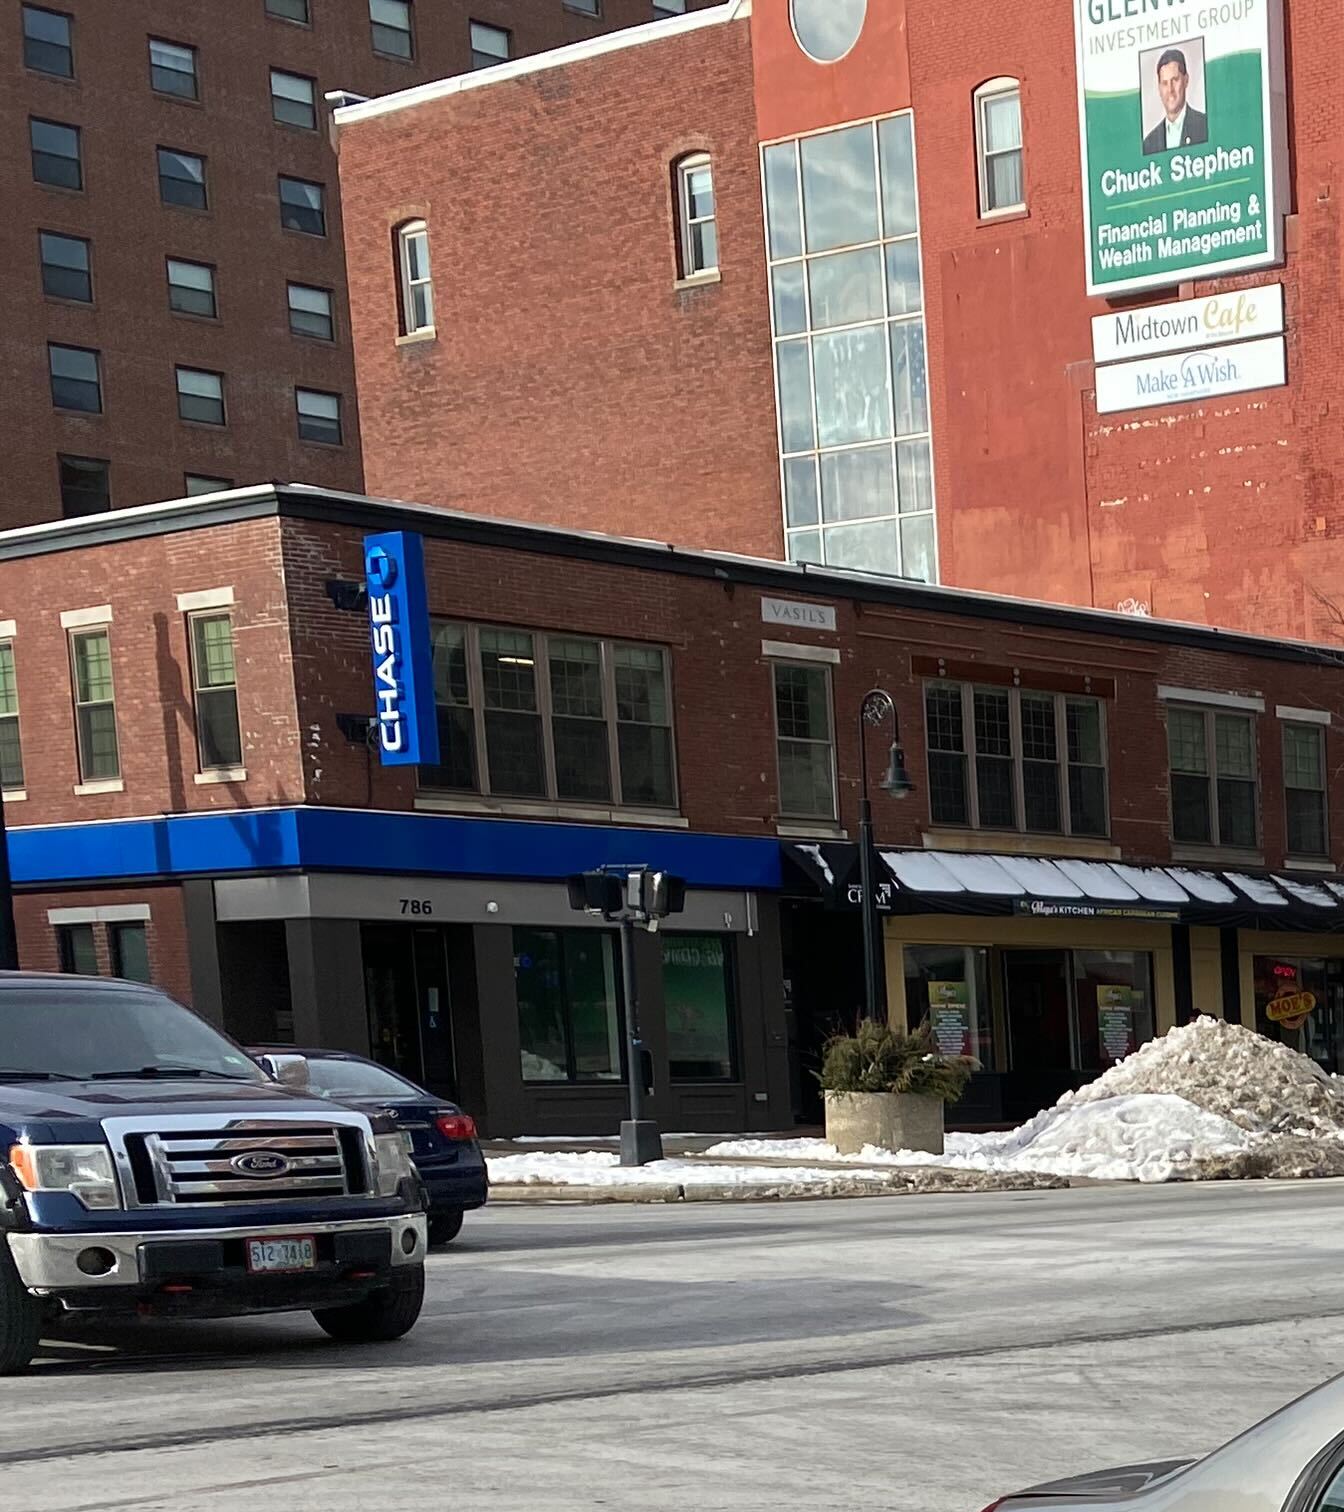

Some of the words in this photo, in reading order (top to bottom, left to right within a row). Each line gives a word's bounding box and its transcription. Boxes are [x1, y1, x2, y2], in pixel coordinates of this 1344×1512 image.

[1089, 14, 1191, 55] INVESTMENT
[1197, 0, 1254, 29] GROUP
[1101, 161, 1162, 197] Chuck
[1170, 144, 1254, 183] Stephen
[1098, 211, 1168, 248] Financial
[1172, 198, 1242, 231] Planning
[1247, 193, 1260, 215] &
[1099, 238, 1153, 270] Wealth
[1157, 220, 1263, 259] Management
[1114, 311, 1199, 347] Midtown
[1202, 294, 1257, 334] Cafe
[1136, 367, 1179, 396] Make
[1183, 366, 1197, 389] A
[1197, 357, 1238, 386] Wish
[370, 593, 403, 753] CHASE
[399, 899, 434, 917] 786
[1059, 905, 1095, 916] KITCHEN
[250, 1157, 277, 1169] Ford
